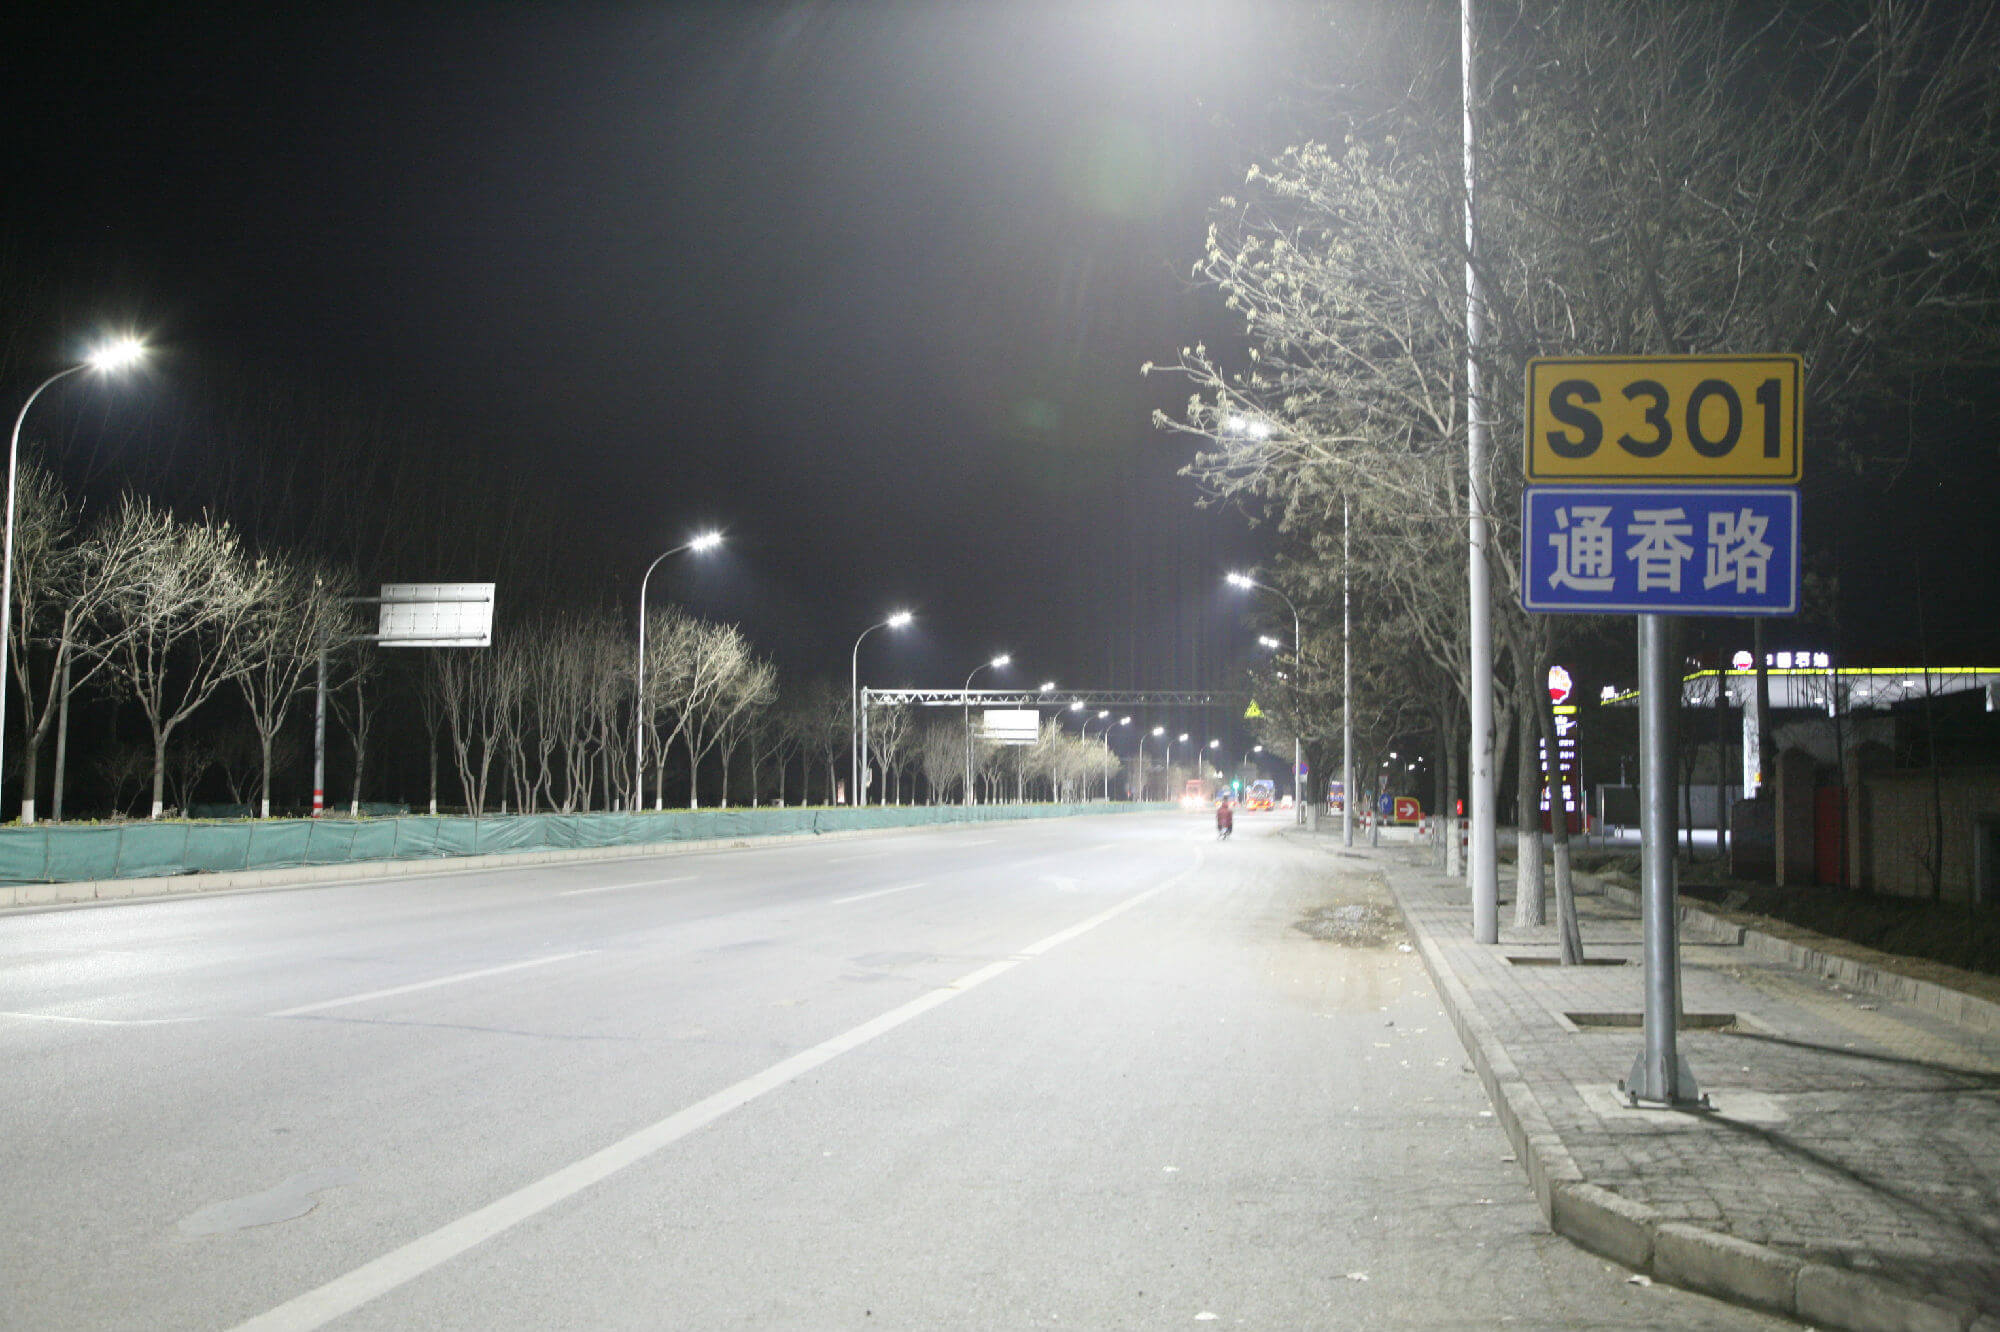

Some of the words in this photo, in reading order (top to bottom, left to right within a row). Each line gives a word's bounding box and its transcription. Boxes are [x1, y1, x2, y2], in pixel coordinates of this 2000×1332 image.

[1546, 378, 1781, 458] S301
[1548, 506, 1774, 594] 通香路
